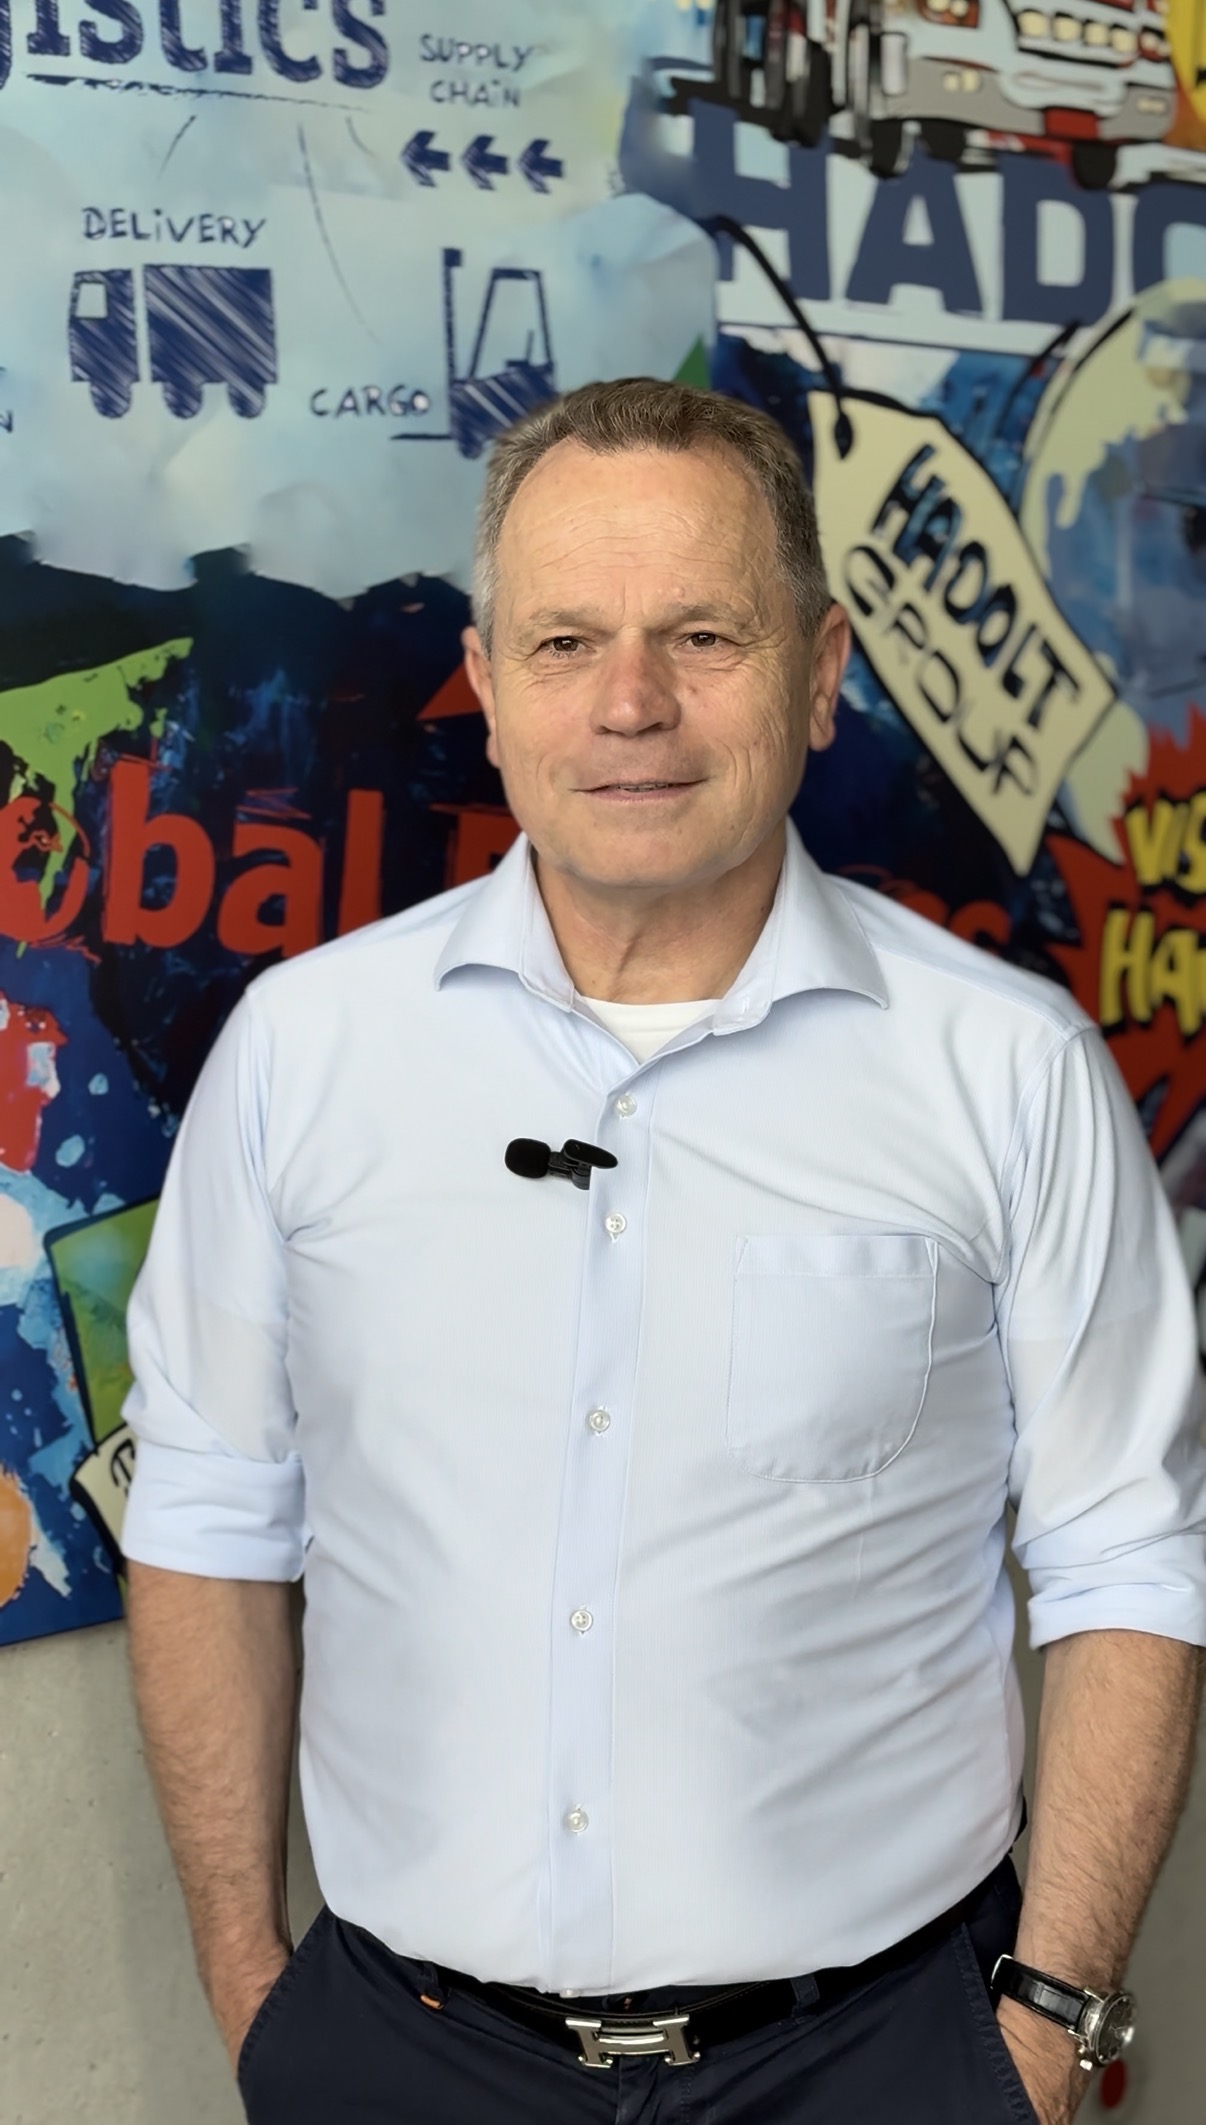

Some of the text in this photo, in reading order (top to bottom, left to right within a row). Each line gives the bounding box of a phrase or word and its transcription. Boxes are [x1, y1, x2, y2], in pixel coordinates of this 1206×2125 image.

[0, 0, 390, 90] istics
[419, 34, 534, 72] SUPPLY
[309, 384, 432, 418] CARGO
